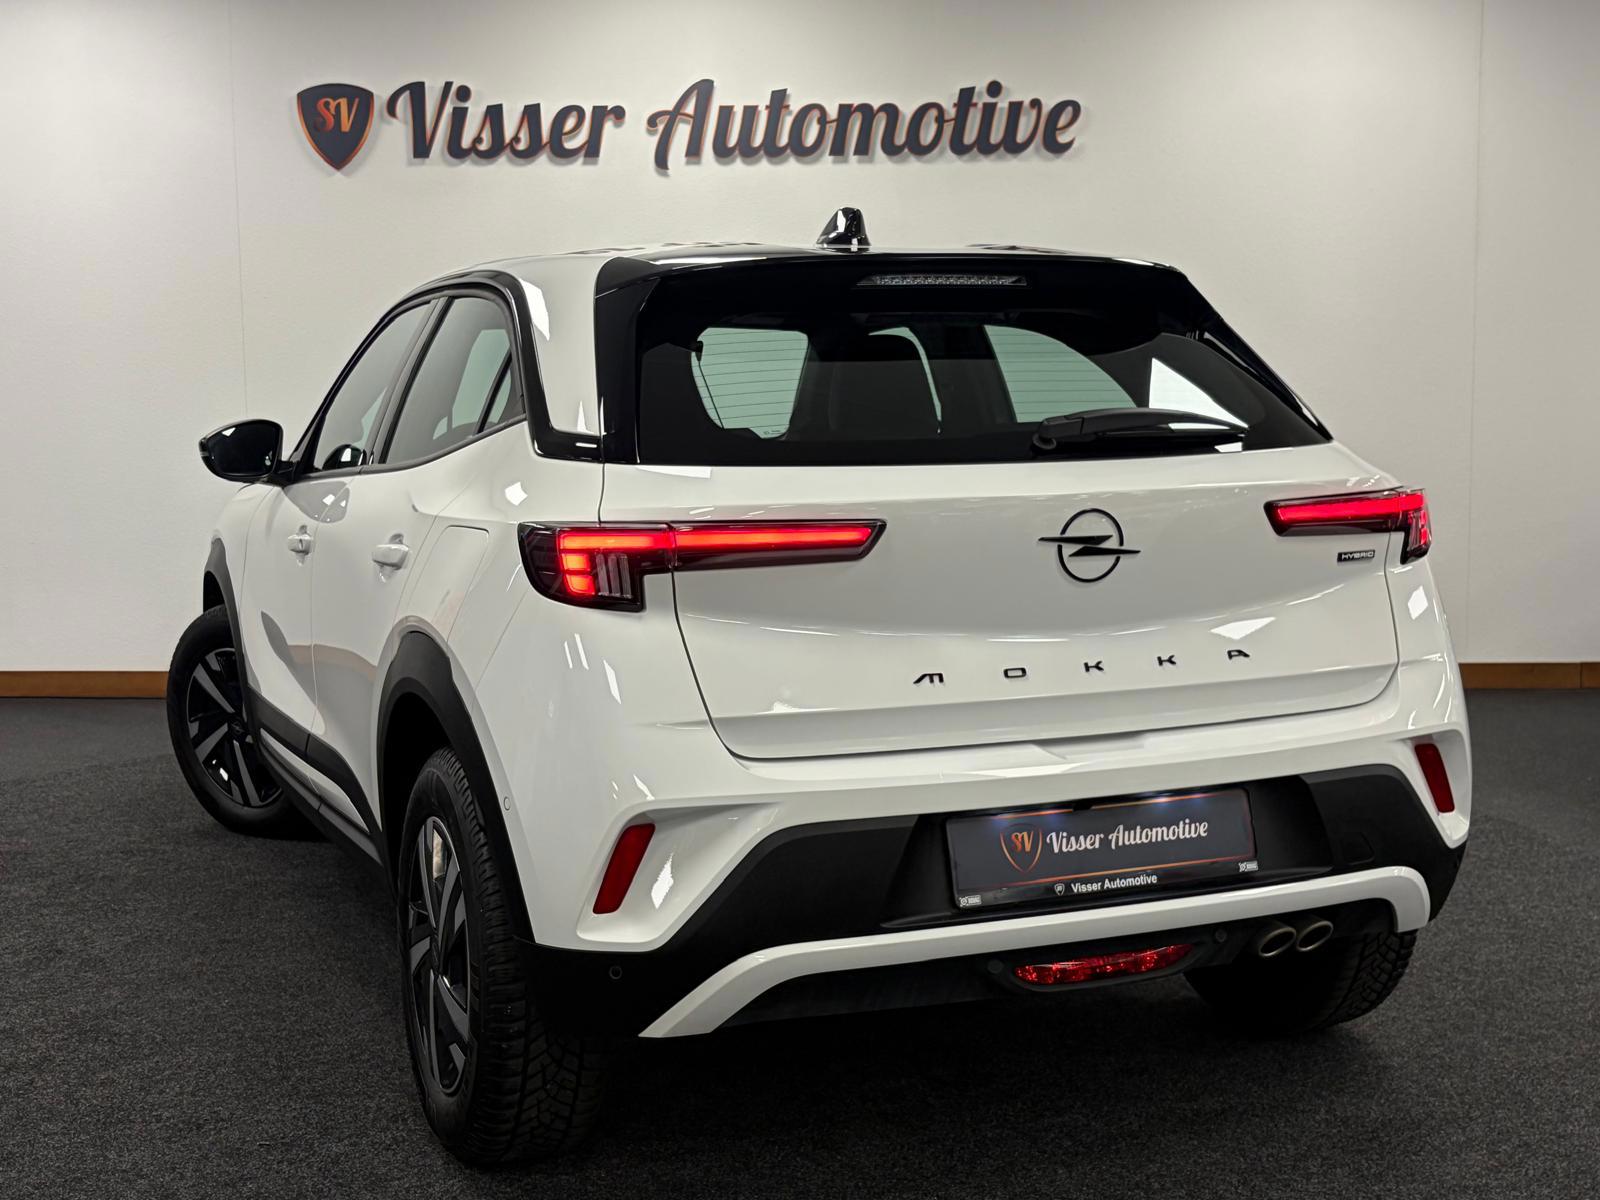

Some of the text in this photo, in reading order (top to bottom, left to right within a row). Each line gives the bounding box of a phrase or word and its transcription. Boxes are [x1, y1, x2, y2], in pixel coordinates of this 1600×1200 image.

[386, 78, 1082, 171] Visser Automotive
[913, 649, 1250, 684] MOKKA
[1046, 818, 1209, 853] Visser Automotive
[1071, 881, 1103, 893] Visser
[1104, 873, 1158, 889] Automotive
